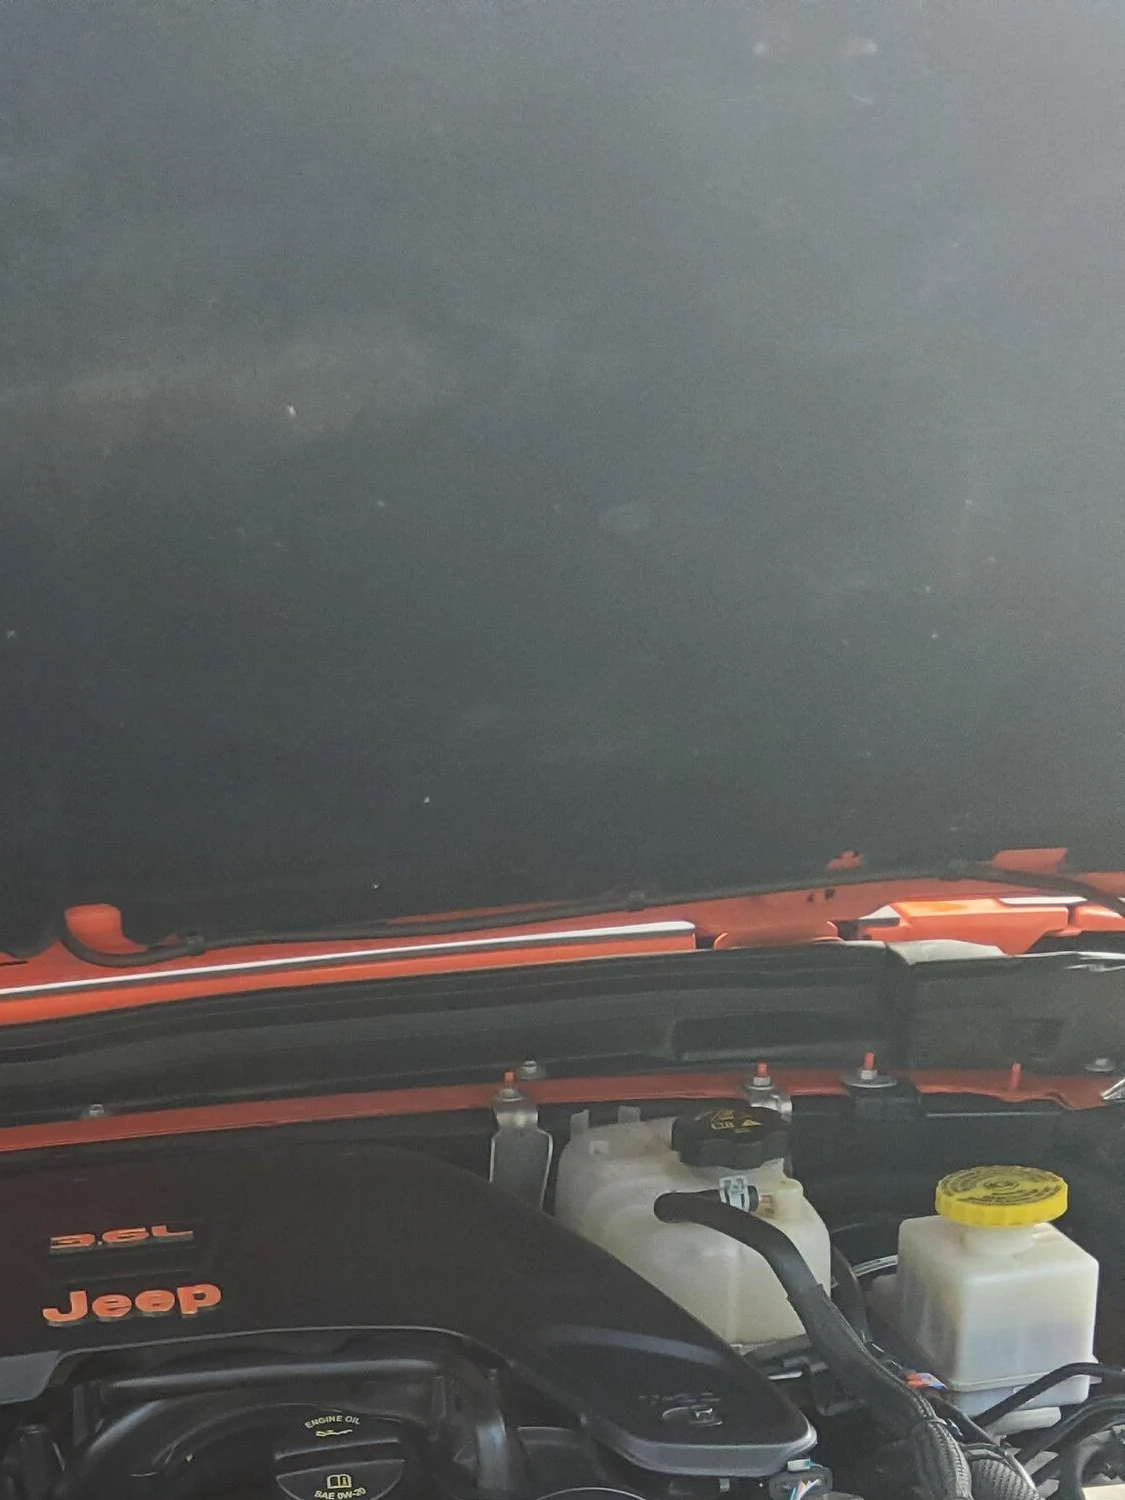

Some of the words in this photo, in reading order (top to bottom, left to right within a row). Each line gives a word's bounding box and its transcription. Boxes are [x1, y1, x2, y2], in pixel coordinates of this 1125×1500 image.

[49, 1225, 194, 1250] 3.6L
[42, 1283, 222, 1323] Jeep
[304, 1415, 343, 1429] ENGINE
[345, 1415, 361, 1425] OIL
[314, 1490, 336, 1500] SAE
[337, 1487, 367, 1500] 0W-20
